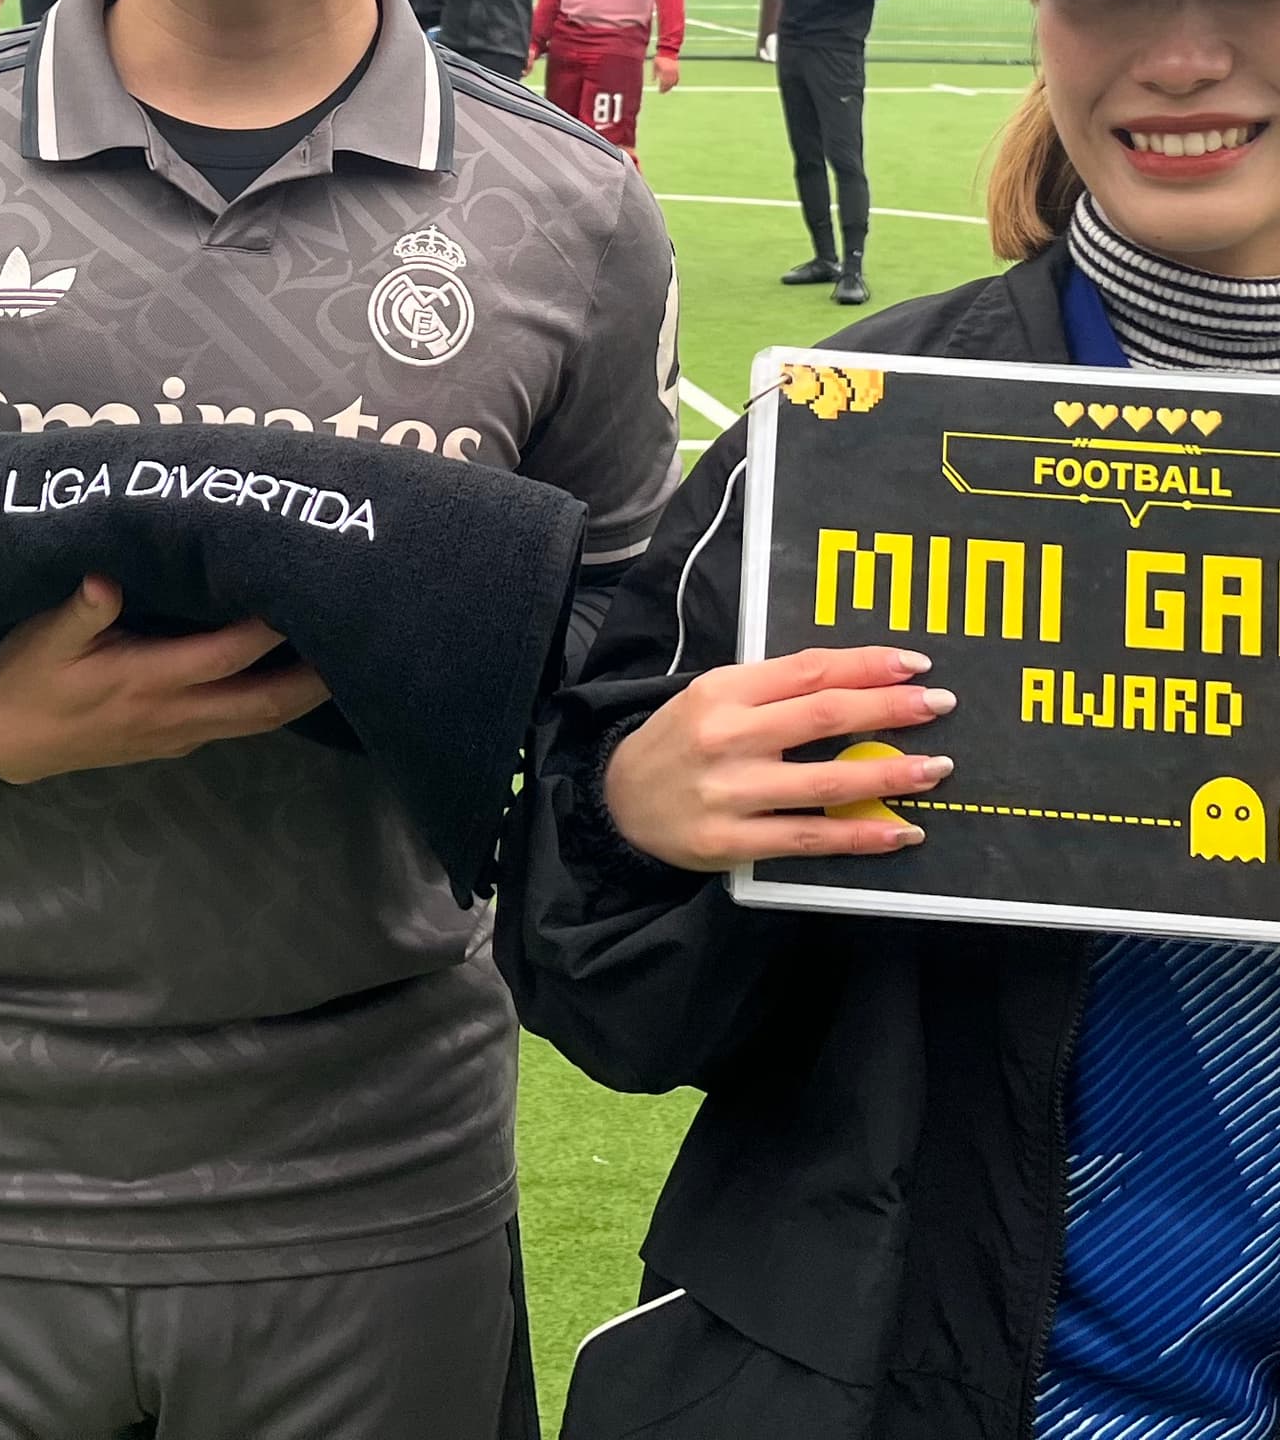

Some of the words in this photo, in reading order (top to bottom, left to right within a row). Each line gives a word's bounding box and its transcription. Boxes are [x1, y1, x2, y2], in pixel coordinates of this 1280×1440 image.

[593, 92, 623, 124] 81
[1033, 457, 1233, 498] FOOTBALL
[814, 528, 1064, 643] MINI
[1021, 666, 1243, 736] AWARD
